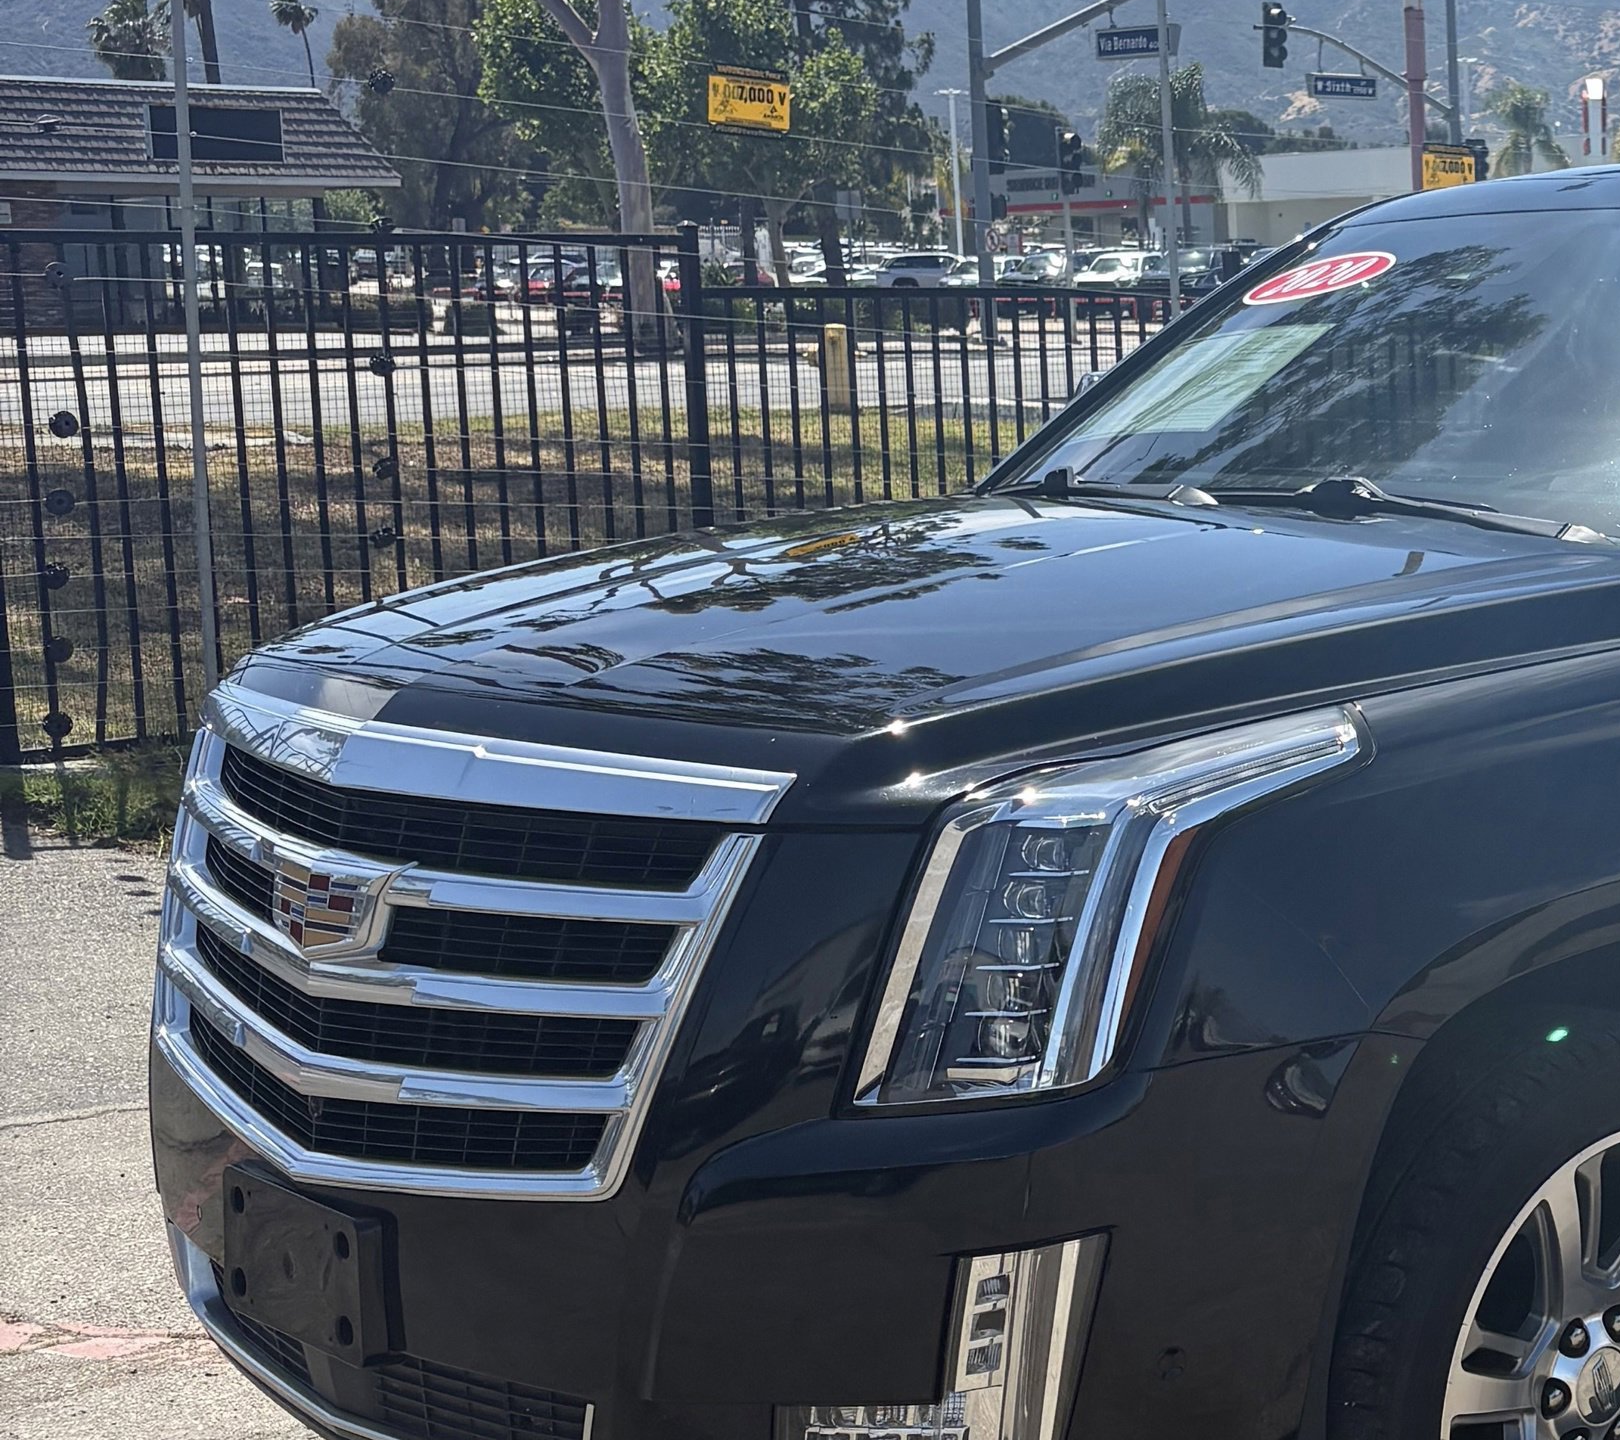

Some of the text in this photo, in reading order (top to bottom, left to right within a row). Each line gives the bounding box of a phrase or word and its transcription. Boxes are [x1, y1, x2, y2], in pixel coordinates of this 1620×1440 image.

[1099, 37, 1112, 51] Via
[1113, 35, 1147, 50] Bernardo
[737, 85, 787, 106] 7,000 V
[1325, 80, 1352, 93] Sixth
[1255, 256, 1380, 299] 2020
